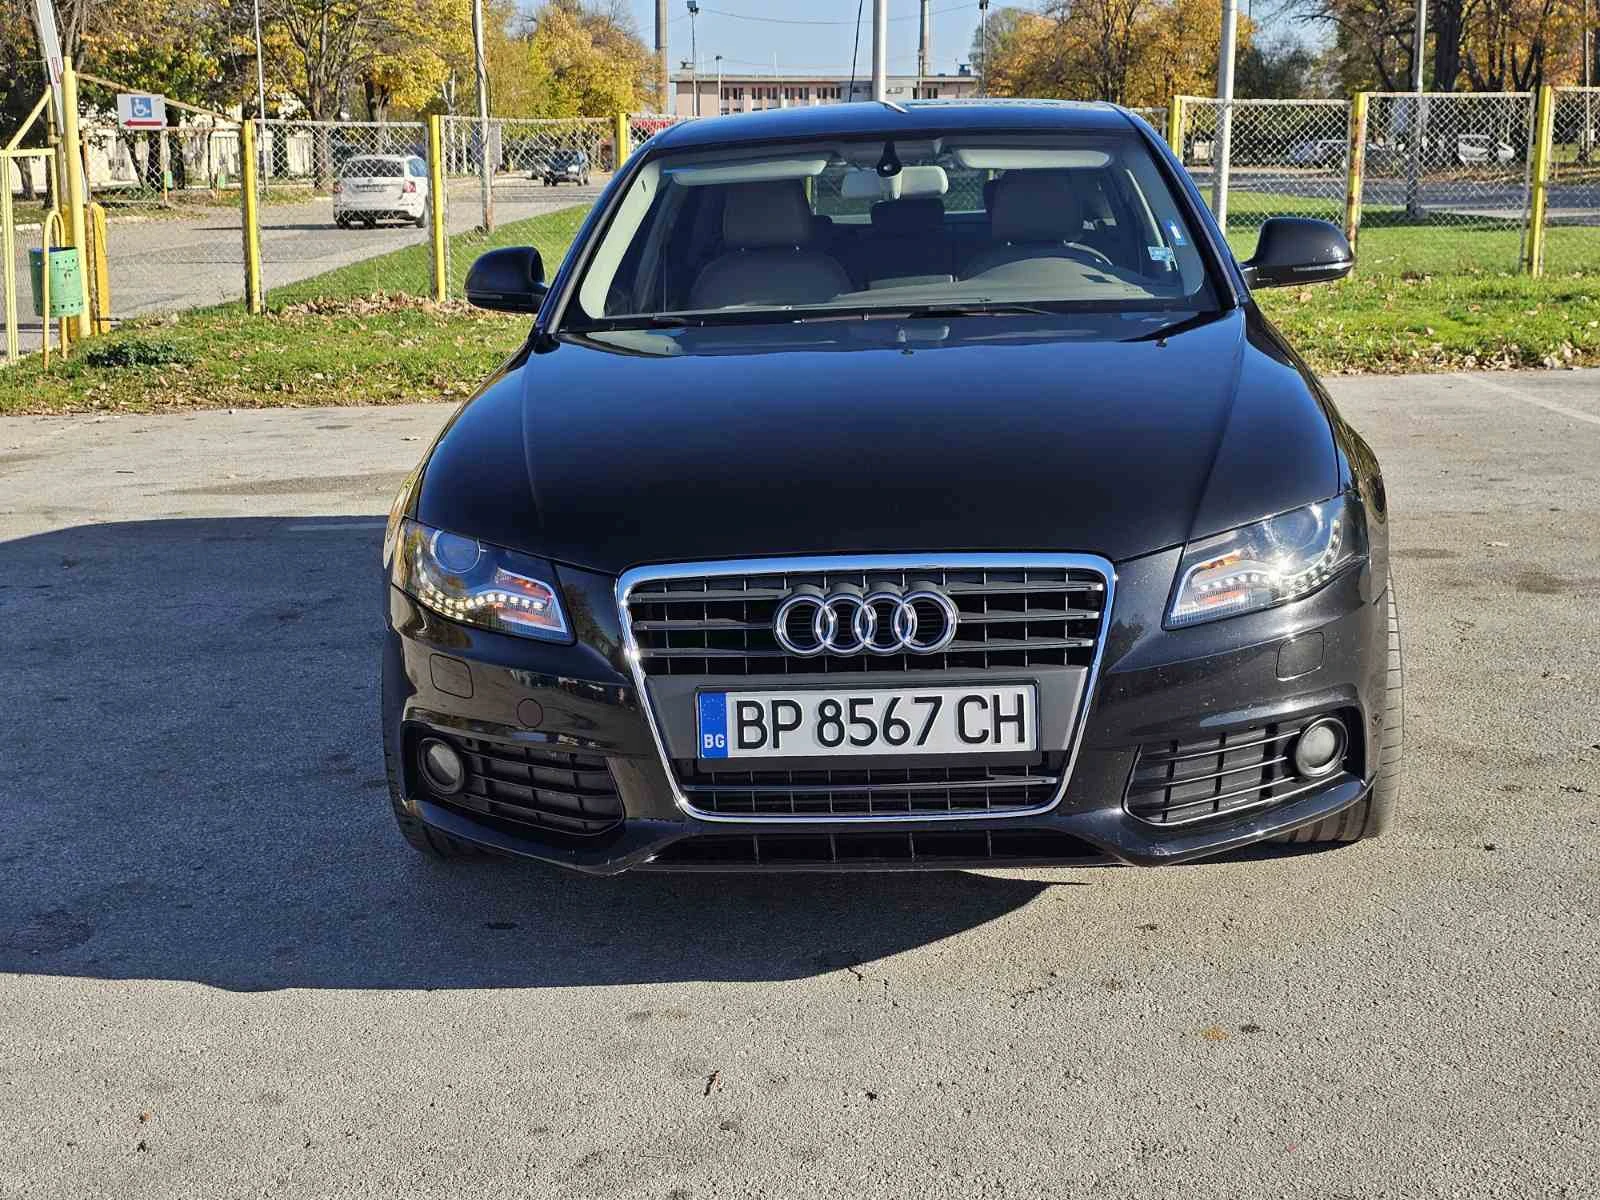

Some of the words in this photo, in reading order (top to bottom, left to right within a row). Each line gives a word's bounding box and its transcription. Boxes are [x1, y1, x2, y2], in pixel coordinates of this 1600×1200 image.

[736, 700, 802, 750] BP
[817, 696, 943, 748] 8567
[957, 693, 1026, 744] CH
[704, 734, 725, 749] BG
